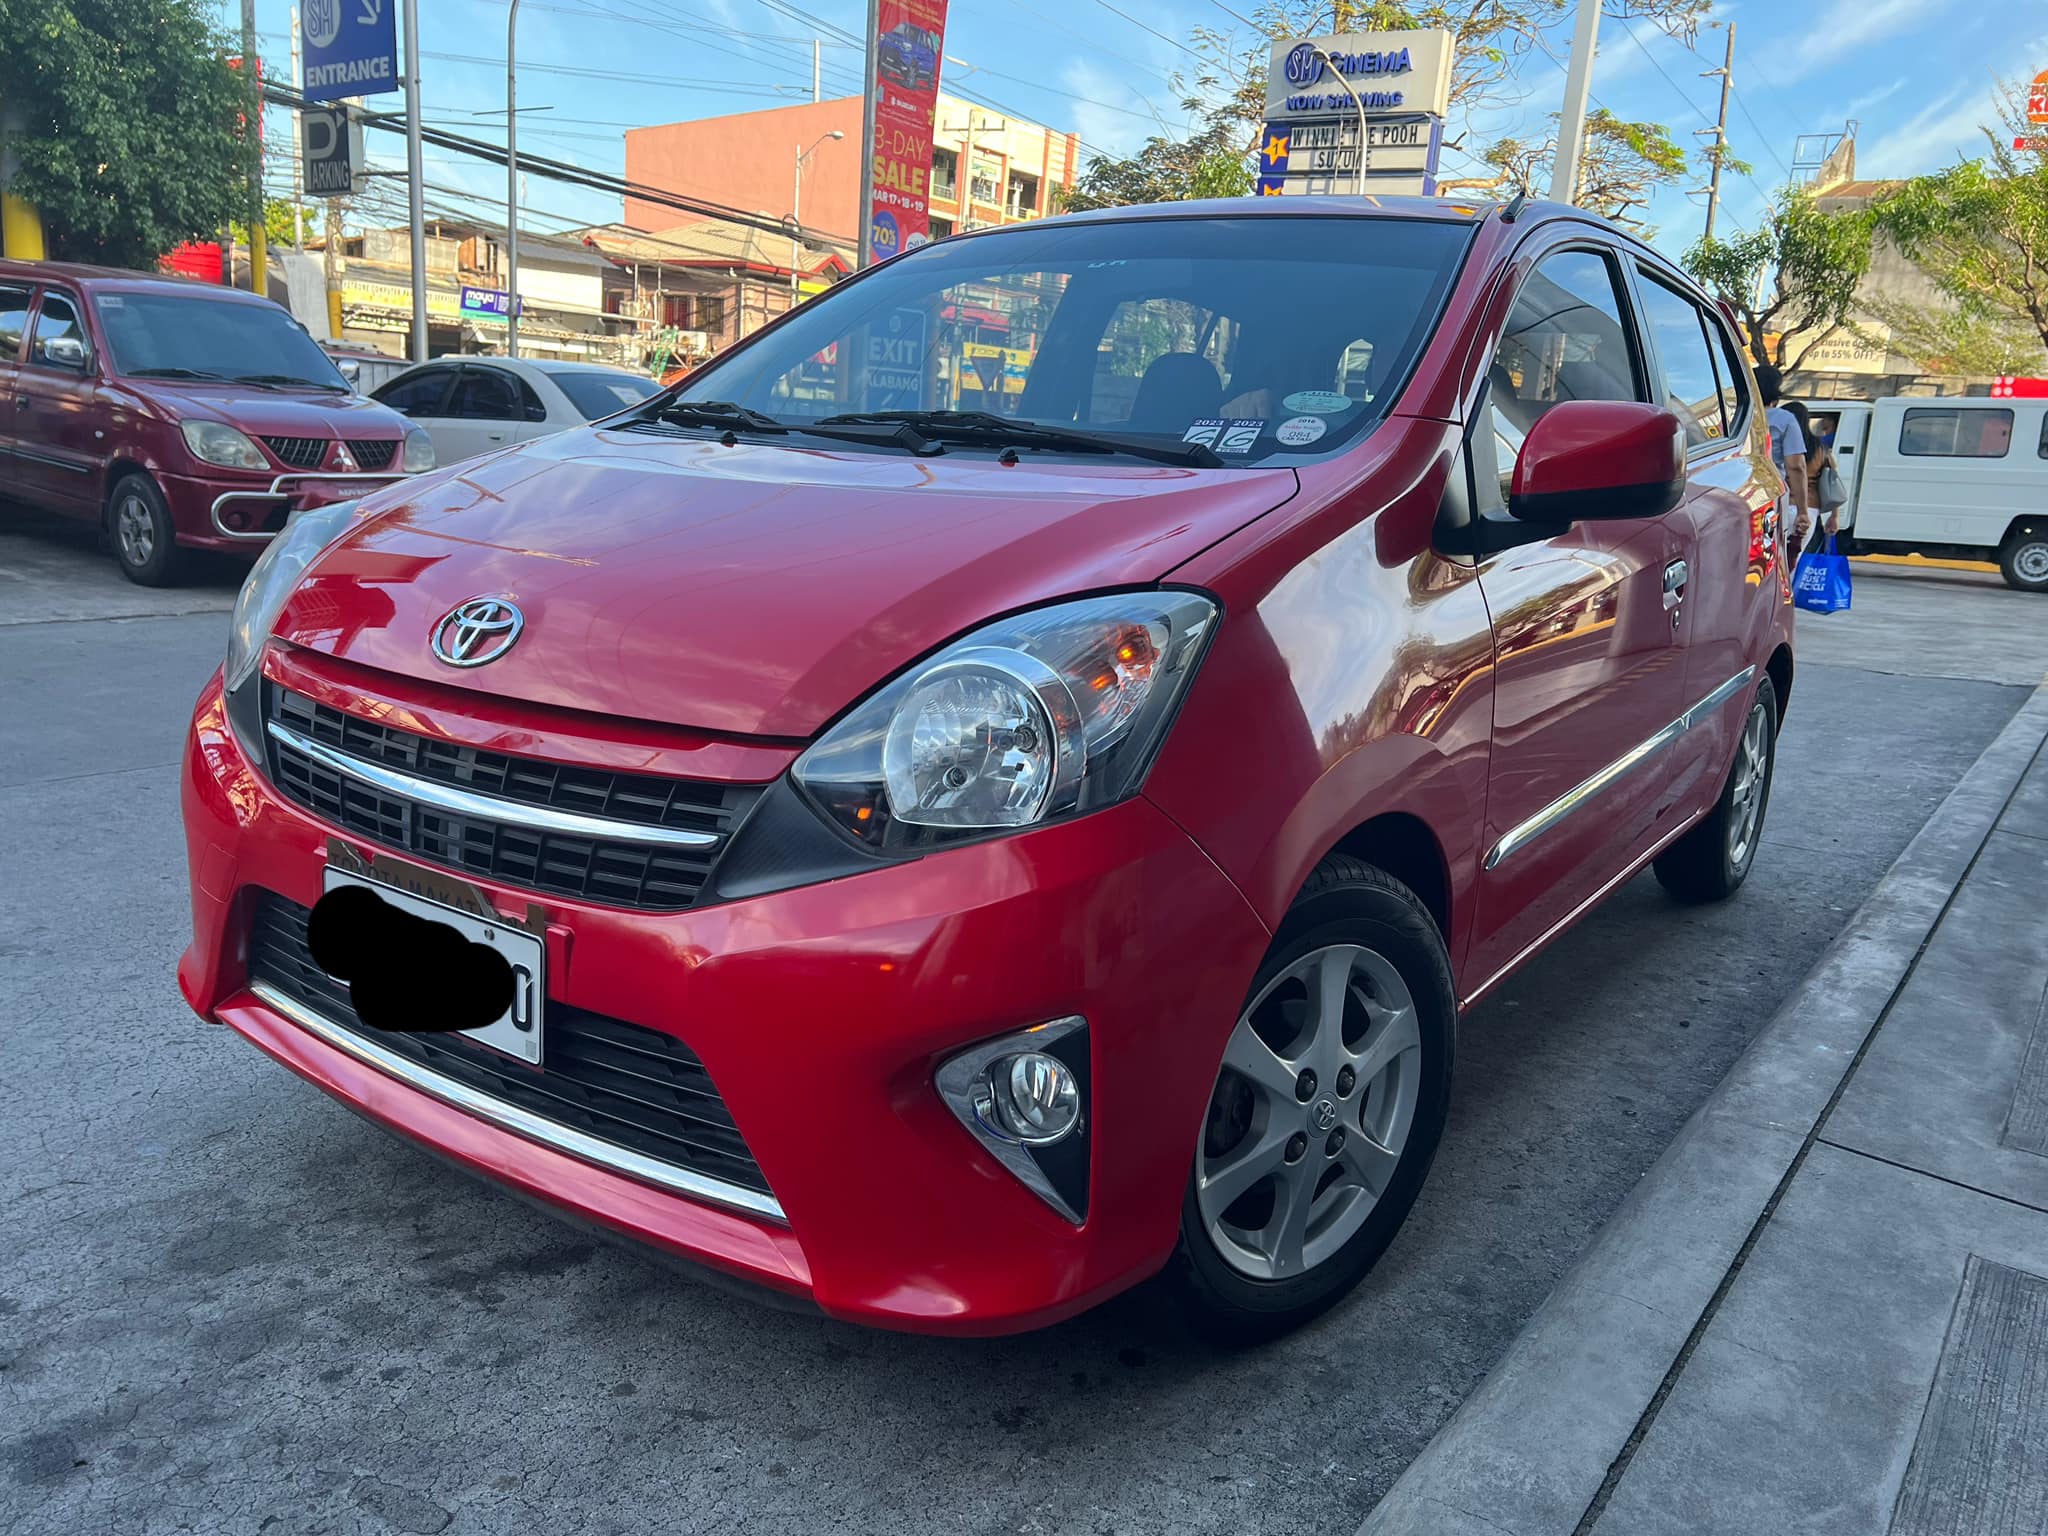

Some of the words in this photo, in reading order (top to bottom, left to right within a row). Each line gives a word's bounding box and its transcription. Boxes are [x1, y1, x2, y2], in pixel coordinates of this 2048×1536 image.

[306, 56, 390, 88] ENTRANCE
[1287, 49, 1316, 82] SM
[1327, 47, 1412, 74] CINEMA
[1286, 93, 1323, 111] NOW
[874, 124, 926, 160] 3-DAY
[1352, 125, 1377, 145] TE
[1382, 124, 1418, 144] POOH
[873, 155, 925, 196] SALE
[465, 290, 494, 304] maya
[869, 336, 918, 365] EXIT
[1233, 419, 1264, 427] 2023
